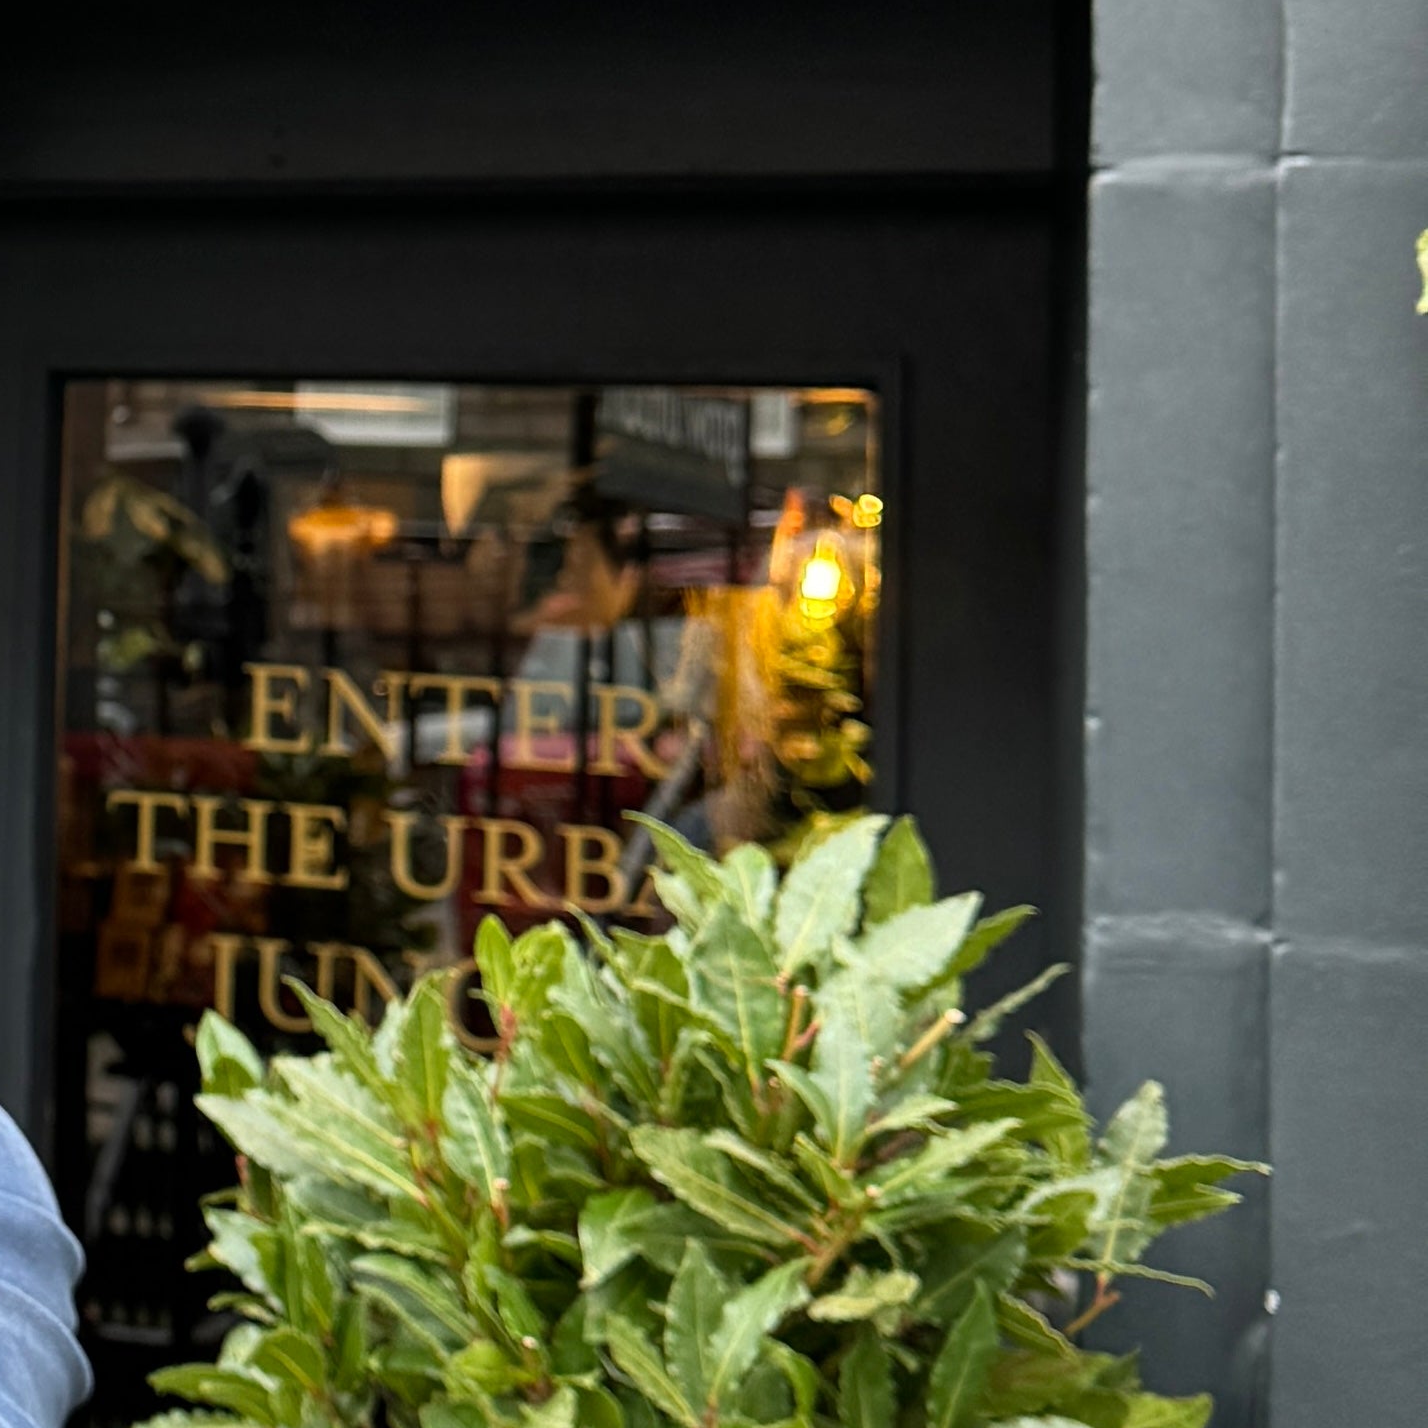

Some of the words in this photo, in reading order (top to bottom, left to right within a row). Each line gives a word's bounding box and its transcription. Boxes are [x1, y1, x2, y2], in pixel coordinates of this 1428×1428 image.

[245, 663, 672, 778] ENTER
[106, 790, 348, 890] THE
[385, 810, 658, 918] URB
